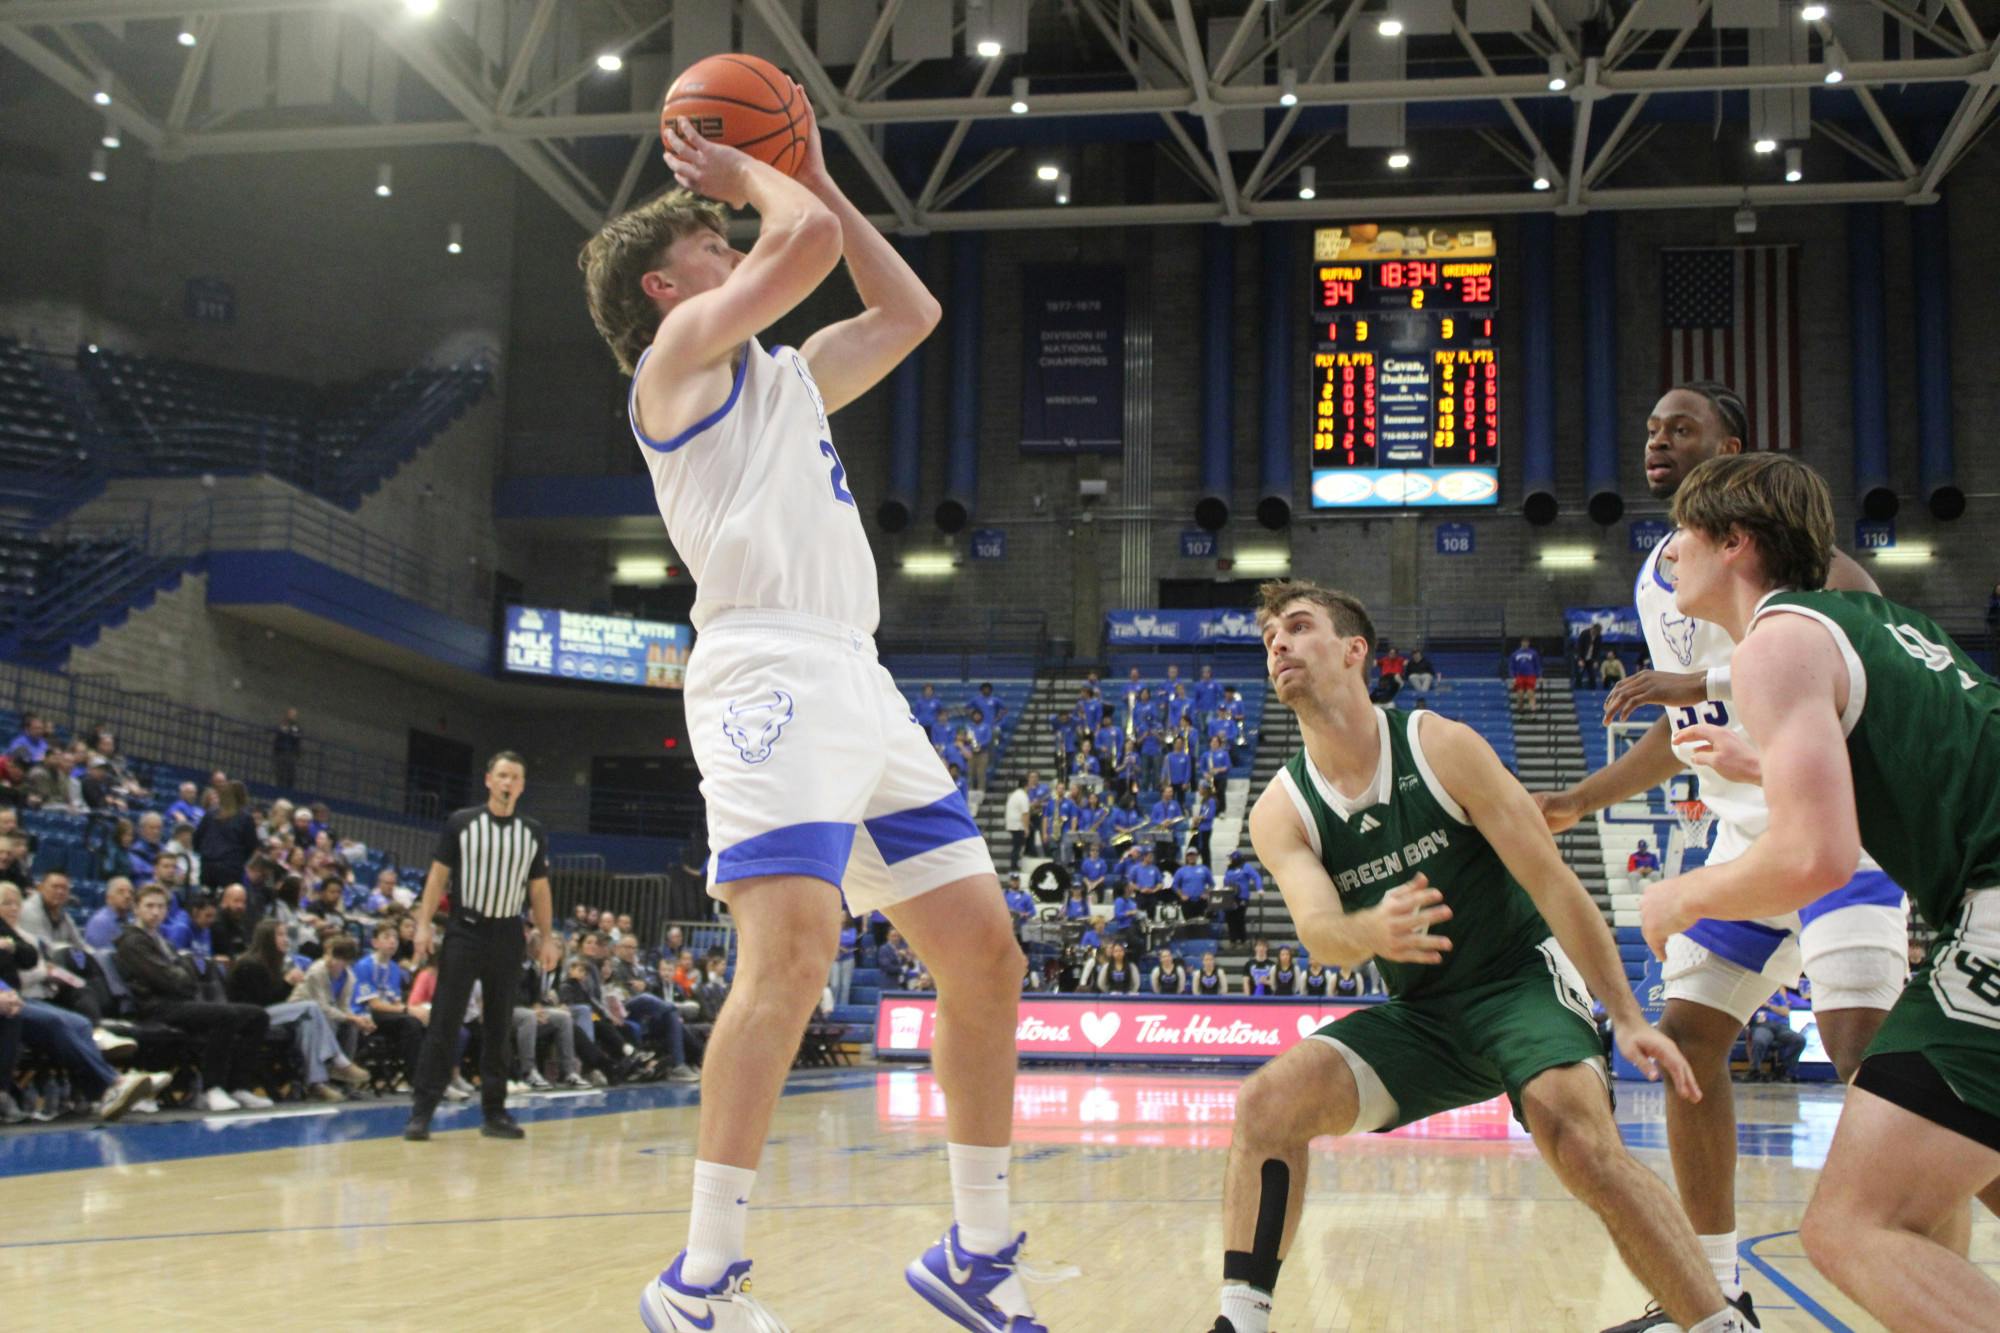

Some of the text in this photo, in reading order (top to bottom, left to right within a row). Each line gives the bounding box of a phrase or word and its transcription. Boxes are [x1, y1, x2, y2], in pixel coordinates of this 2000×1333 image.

[1320, 267, 1362, 281] BUFFALO
[1381, 262, 1436, 288] 18:34
[1324, 281, 1353, 306] 34
[1462, 277, 1491, 302] 32
[1411, 289, 1424, 310] 2
[1041, 331, 1093, 341] DIVISION
[1329, 322, 1337, 341] 1
[1355, 321, 1368, 342] 3
[1441, 318, 1454, 339] 3
[1484, 319, 1492, 337] 1
[1044, 343, 1103, 354] NATIONAL
[1435, 350, 1494, 364] PLY FL PTS
[1039, 357, 1109, 367] CHAMPIONS
[1315, 352, 1373, 367] PLY FL PTS
[1327, 366, 1376, 382] 1 0 3
[1443, 363, 1496, 380] 2 1 0
[1322, 382, 1376, 399] 2 0 5
[1443, 379, 1497, 396] 4 2 6
[1318, 399, 1376, 416] 10 0 5
[1439, 397, 1454, 413] 10
[1464, 397, 1475, 413] 0
[1318, 417, 1376, 432] 14 1 4
[1384, 414, 1425, 424] Insurance
[1439, 414, 1496, 430] 13 2 4
[1343, 432, 1355, 449] 2
[1364, 432, 1376, 448] 9
[1434, 430, 1497, 448] 23 1 3
[1348, 450, 1355, 465] 1
[1469, 448, 1476, 463] 1
[820, 439, 855, 508] 2
[1187, 541, 1212, 555] 107
[1442, 537, 1469, 551] 108
[1864, 532, 1889, 547] 110
[977, 543, 1000, 557] 106
[560, 609, 634, 635] RECOVER
[635, 620, 676, 640] WITH
[508, 630, 552, 650] MILK
[560, 626, 601, 644] REAL
[517, 648, 552, 669] LIFE
[1403, 829, 1449, 867] BAY
[1135, 1014, 1280, 1045] Tim Hortons
